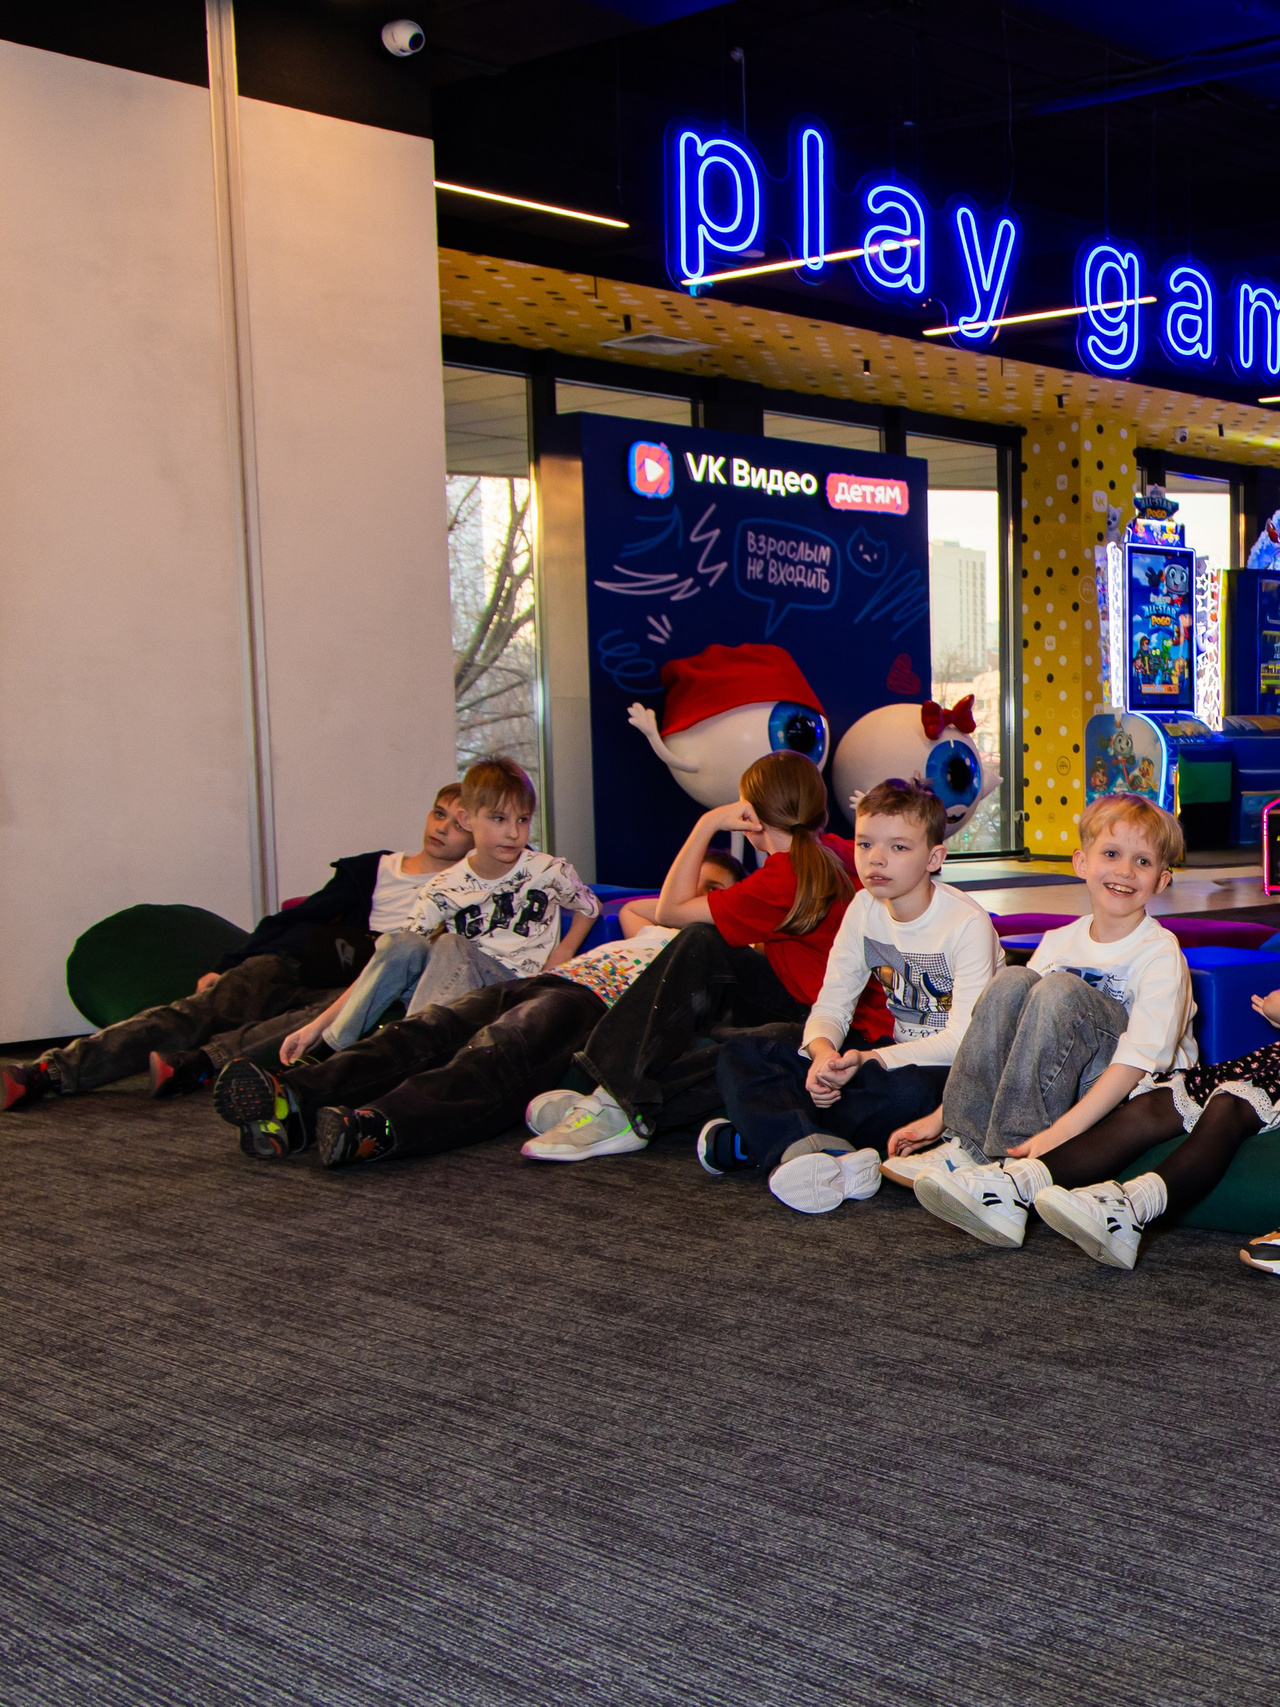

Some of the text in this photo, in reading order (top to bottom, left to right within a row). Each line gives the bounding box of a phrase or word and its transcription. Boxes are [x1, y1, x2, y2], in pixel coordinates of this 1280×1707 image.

[678, 127, 1017, 340] play
[686, 451, 819, 497] VK Видео
[834, 481, 903, 505] детям
[746, 530, 831, 566] ВЗРОСЛЫМ
[768, 564, 831, 594] ВХОДИТЬ
[453, 888, 549, 940] GAP
